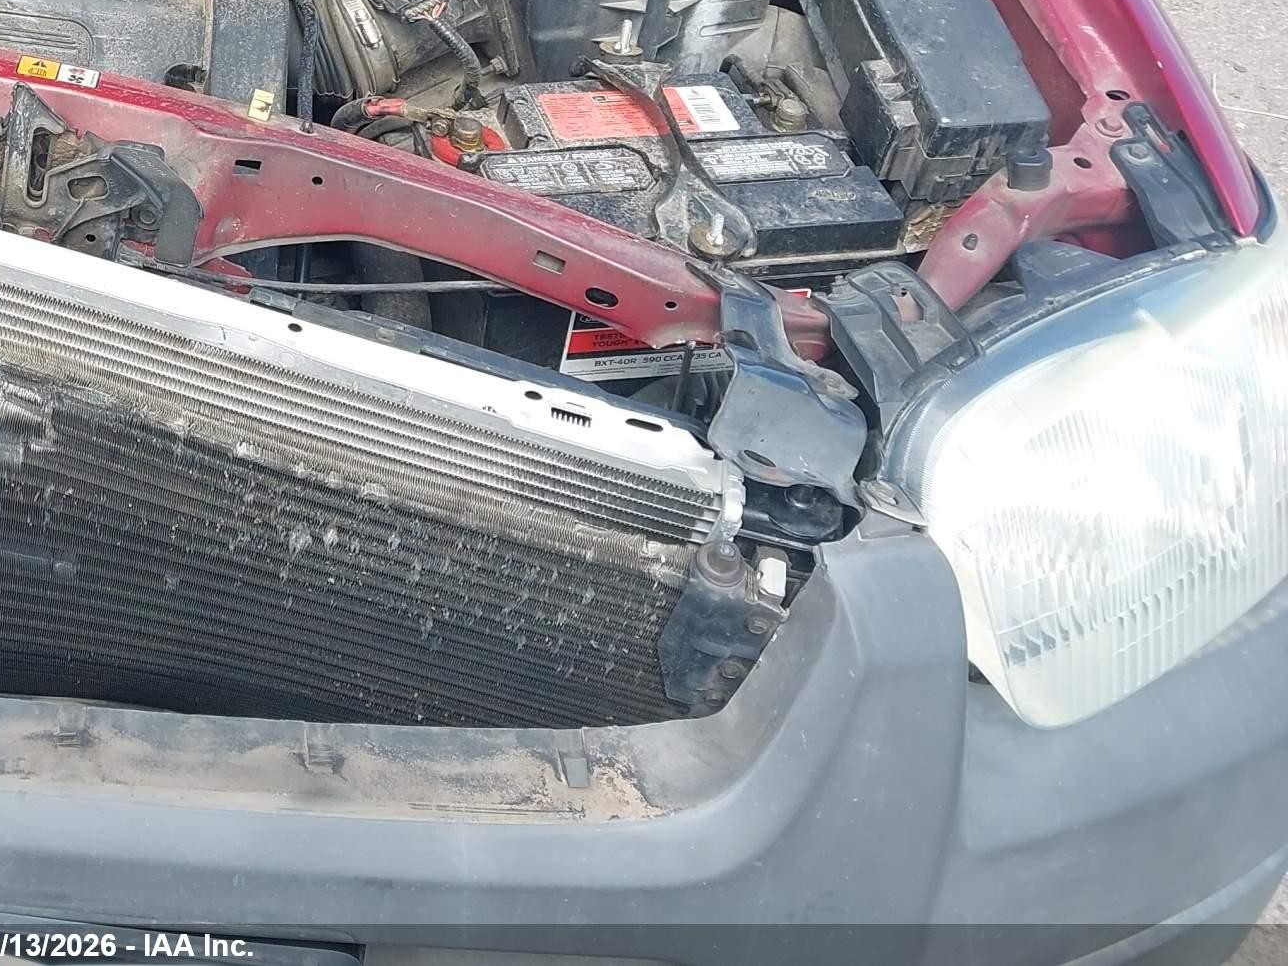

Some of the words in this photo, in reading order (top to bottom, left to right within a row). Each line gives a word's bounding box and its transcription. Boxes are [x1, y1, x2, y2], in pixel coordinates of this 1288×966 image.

[519, 155, 562, 163] DANGER
[571, 150, 612, 159] POISON
[594, 358, 638, 367] BXT-40R
[643, 356, 662, 364] 590
[663, 354, 683, 362] CCA
